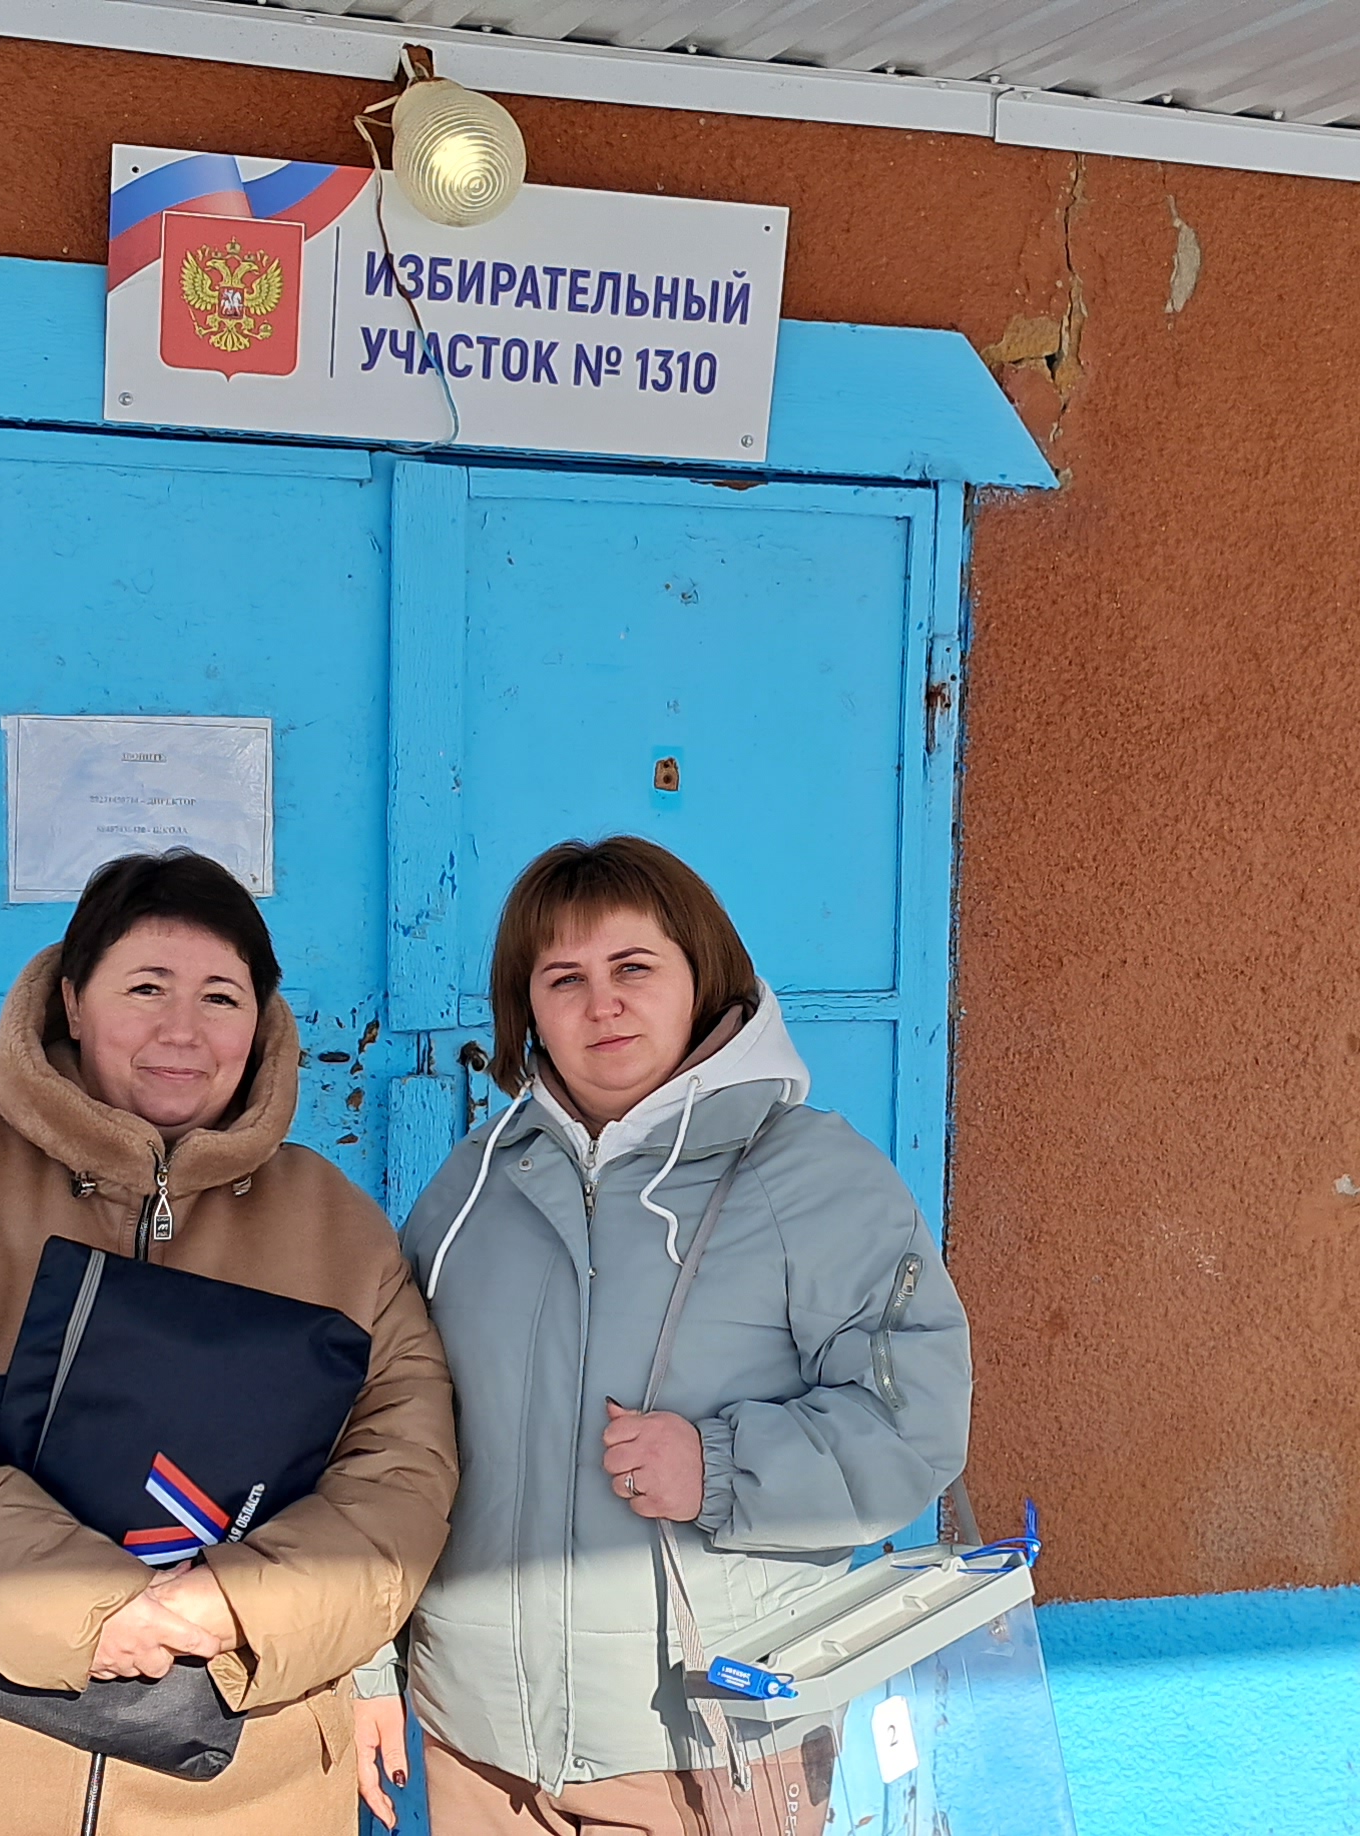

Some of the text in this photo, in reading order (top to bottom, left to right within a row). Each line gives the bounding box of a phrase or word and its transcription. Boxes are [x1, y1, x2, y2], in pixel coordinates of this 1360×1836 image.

[364, 250, 752, 326] ИЗБИРАТЕЛЬНЫЙ
[359, 326, 718, 395] УЧАСТОК № 1310
[234, 1482, 266, 1529] ОБЛАСТЬ
[886, 1724, 899, 1747] 2
